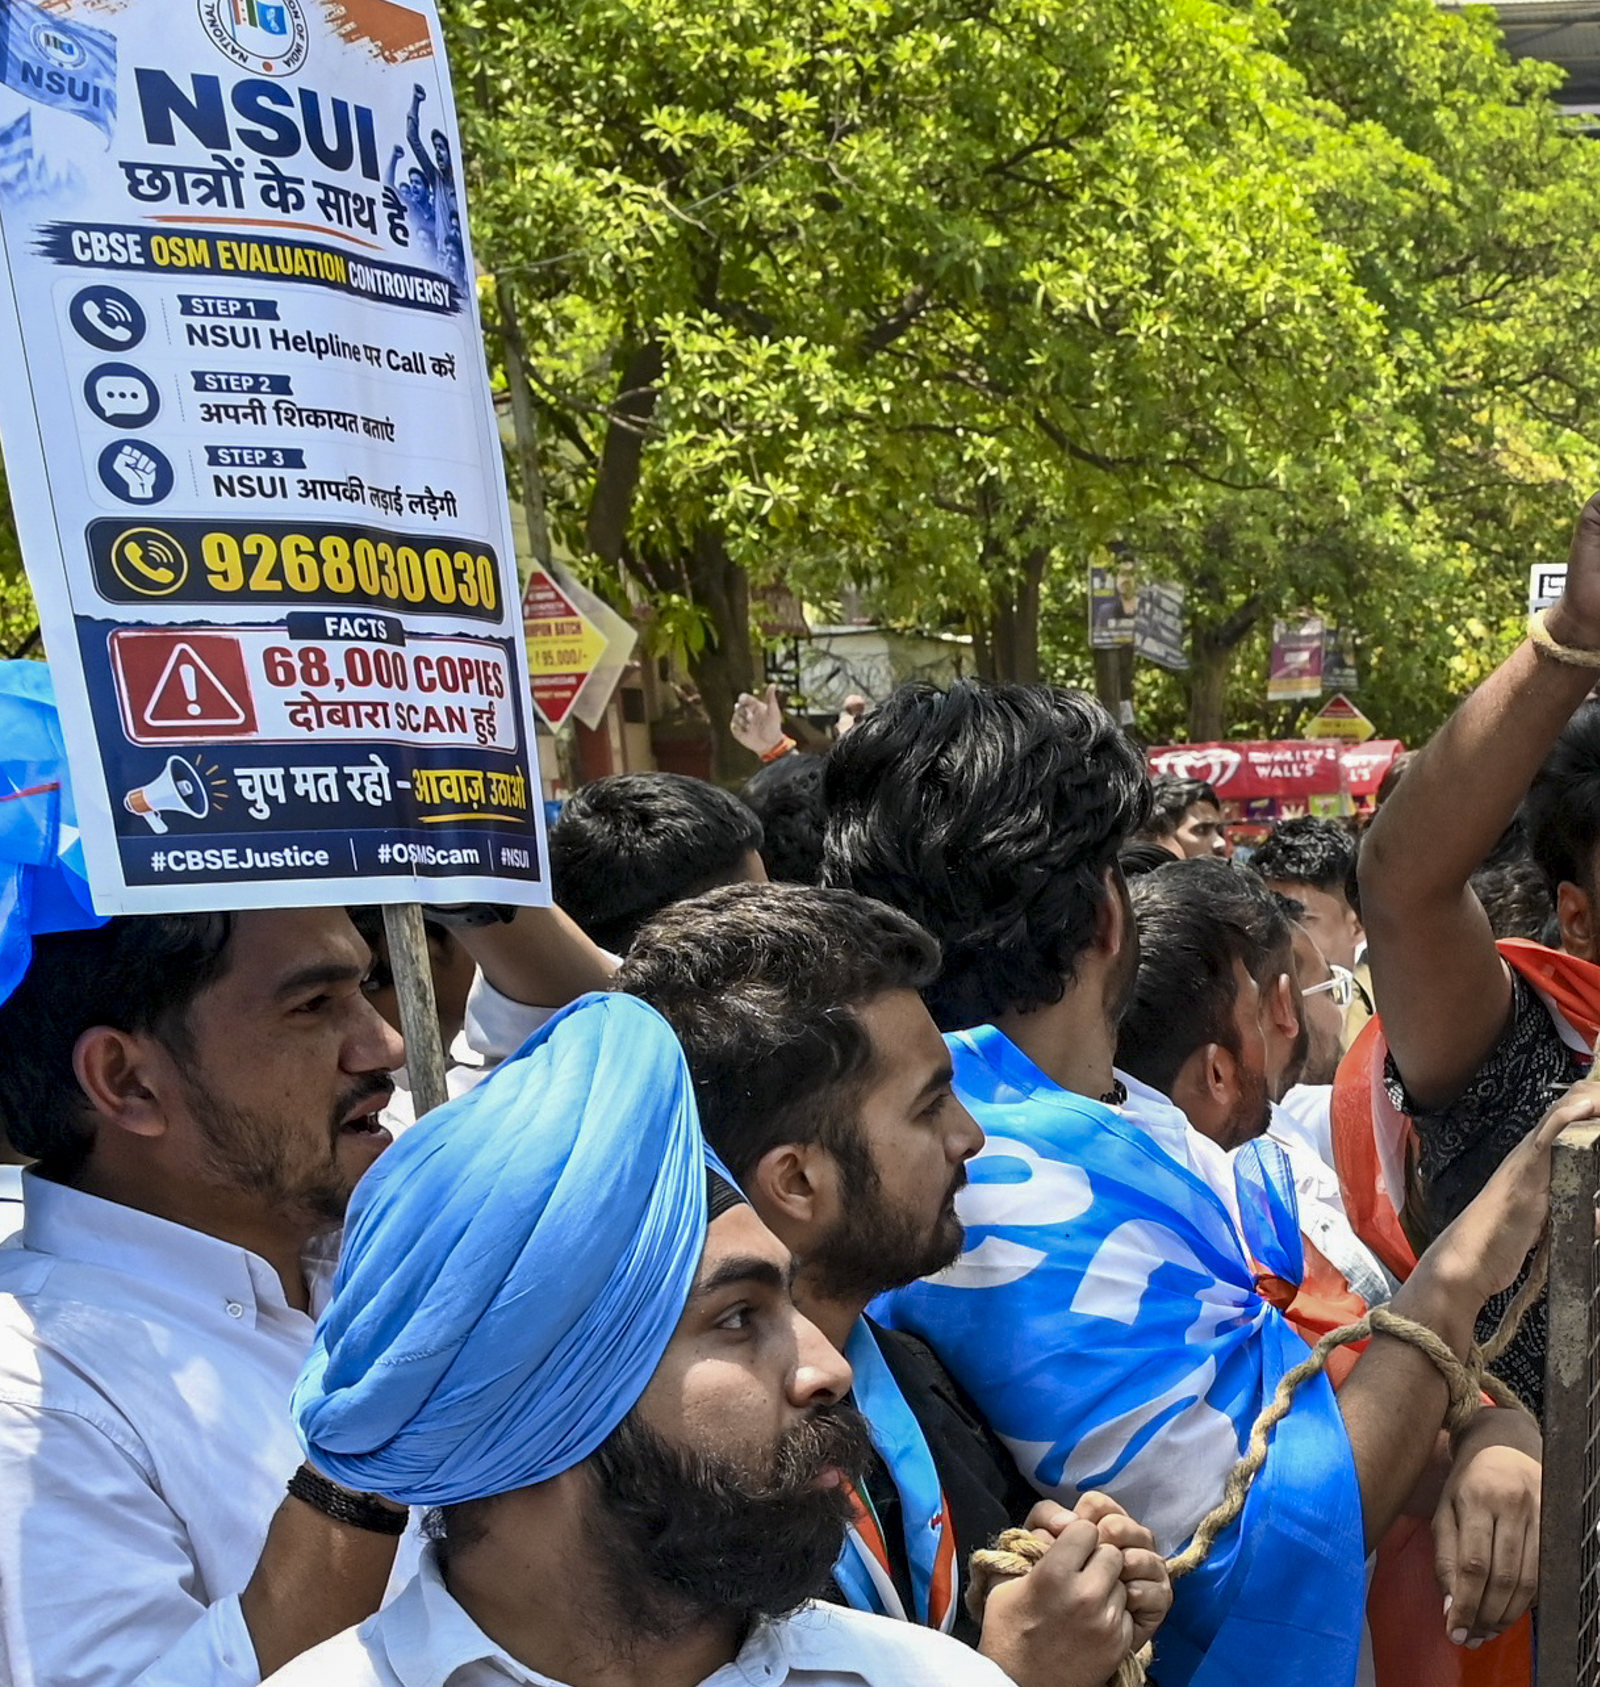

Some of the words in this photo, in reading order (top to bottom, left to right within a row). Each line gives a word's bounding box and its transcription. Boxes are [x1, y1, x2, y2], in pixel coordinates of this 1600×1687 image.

[21, 63, 100, 108] NSUI
[134, 67, 380, 182] NSUI
[119, 155, 245, 209] छात्रों
[255, 159, 305, 214] के
[313, 180, 377, 236] साथ
[383, 186, 410, 248] है
[71, 229, 145, 266] CBSE
[150, 234, 211, 269] OSM
[218, 239, 347, 286] EVALUATION
[348, 259, 451, 308] CONTROVERSY
[191, 297, 240, 315] STEP
[246, 300, 257, 316] 1
[186, 324, 260, 349] NSUI
[272, 329, 360, 363] Helpline
[363, 343, 382, 367] पर
[386, 350, 427, 377] Call
[429, 351, 457, 381] करें
[204, 373, 255, 391] STEP
[260, 375, 272, 393] 2
[200, 398, 267, 426] अपनी
[272, 399, 359, 434] शिकायत
[360, 416, 396, 442] बताएं
[218, 448, 267, 465] STEP
[272, 450, 284, 466] 3
[213, 474, 289, 499] NSUI
[296, 475, 366, 505] आपकी
[367, 485, 403, 517] लड़ाई
[201, 531, 497, 610] 9268030030
[324, 616, 388, 639] FACTS
[262, 646, 409, 693] 68,000
[413, 655, 505, 699] COPIES
[284, 691, 391, 732] दोबारा
[396, 702, 469, 734] SCAN
[233, 767, 287, 821] चुप
[290, 765, 340, 803] मत
[343, 754, 393, 806] रहो
[412, 768, 485, 810] आवाज़
[487, 765, 527, 810] उठाओ
[150, 845, 330, 873] #CBSEJustice
[377, 843, 480, 866] #OSMScam
[500, 848, 531, 869] #NSUI
